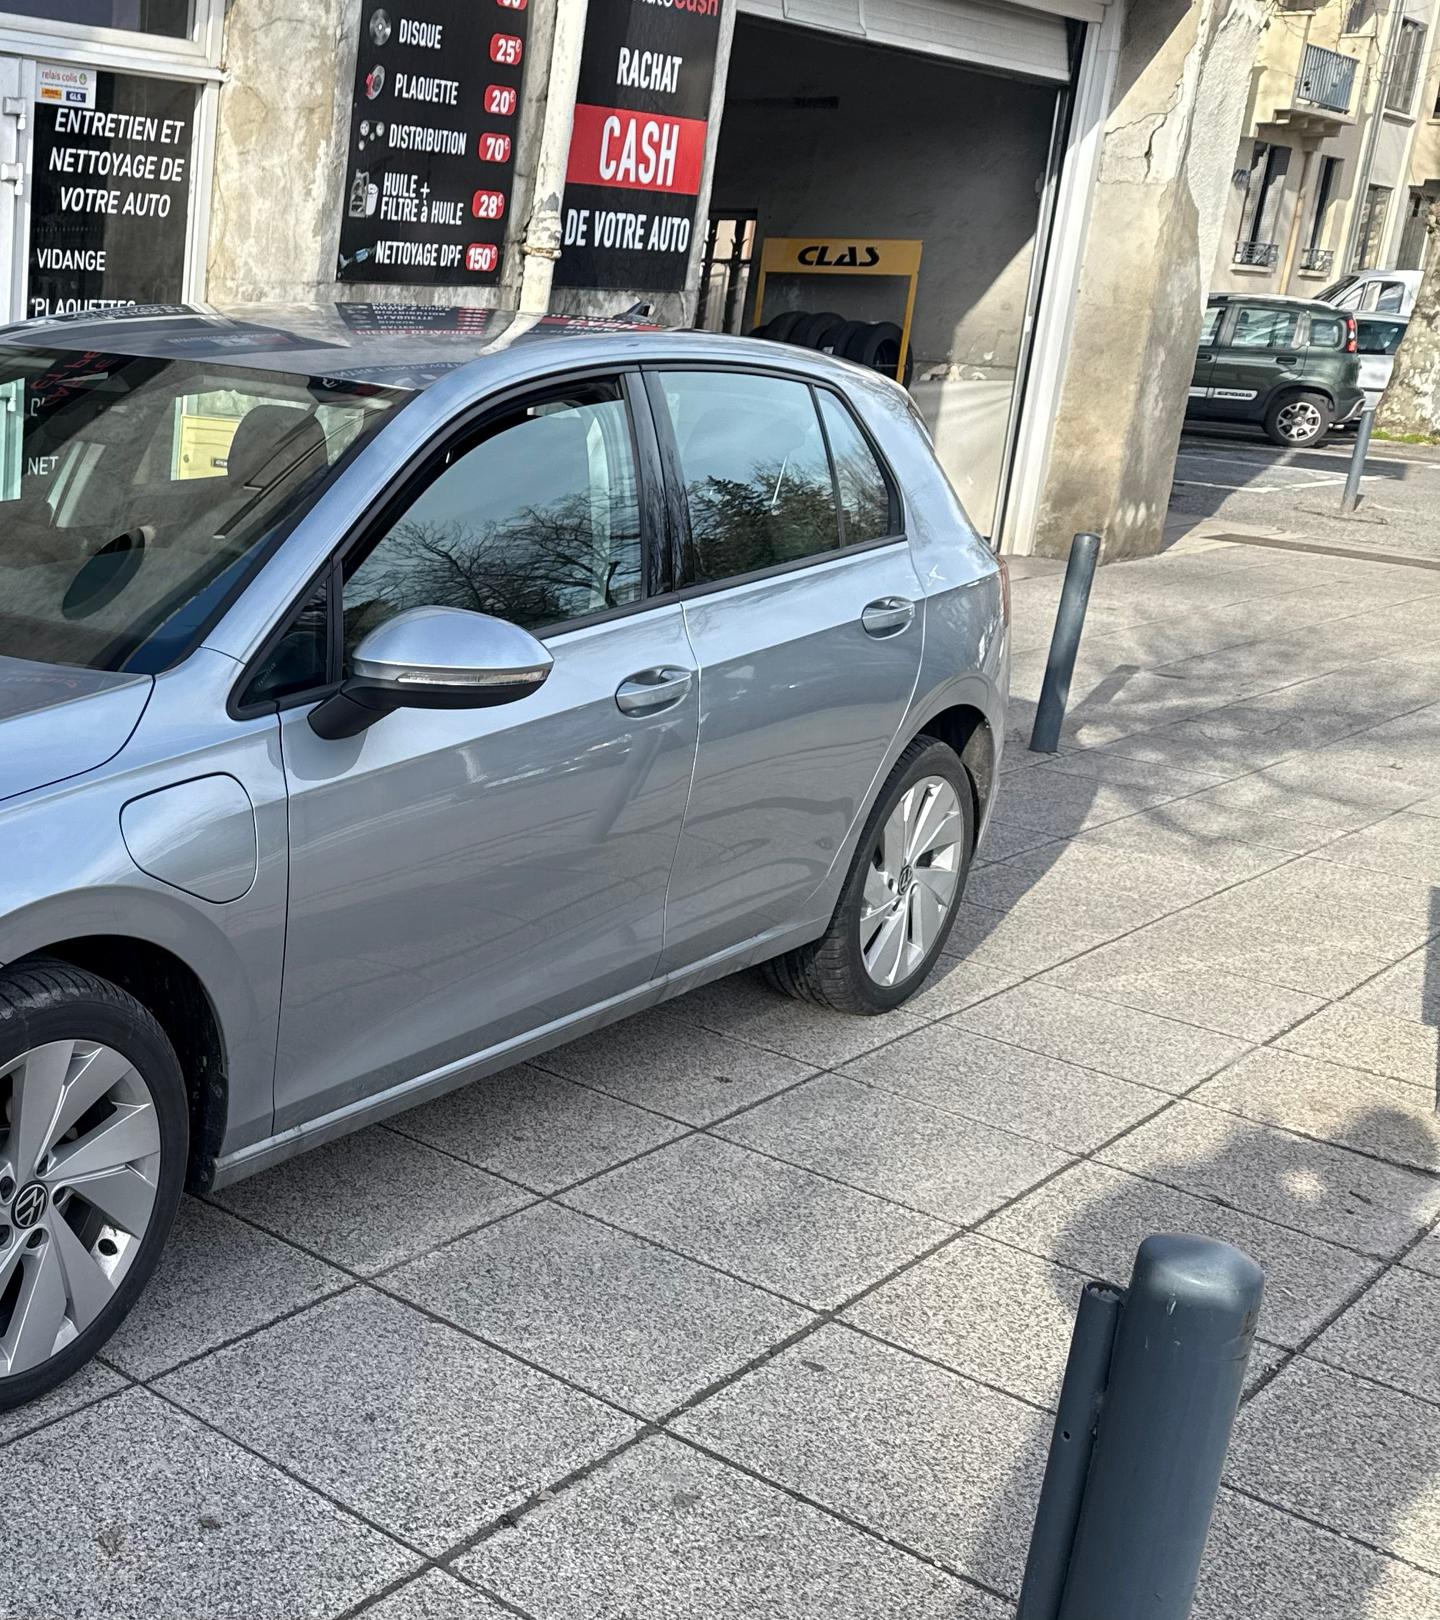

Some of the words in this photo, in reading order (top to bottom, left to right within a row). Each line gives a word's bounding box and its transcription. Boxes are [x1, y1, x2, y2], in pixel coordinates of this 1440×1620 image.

[398, 19, 443, 50] DISQUE
[616, 46, 683, 94] RACHAT
[394, 73, 460, 106] PLAQUETTE
[54, 107, 158, 142] ENTRETIEN
[160, 119, 185, 145] ET
[388, 123, 467, 156] DISTRIBUTION
[48, 146, 158, 180] NETTOYAGE
[159, 157, 185, 182] DE
[599, 115, 680, 187] CASH
[382, 172, 419, 198] HUILE
[60, 186, 121, 215] VOTRE
[122, 192, 172, 218] AUTO
[380, 196, 418, 222] FILTRE
[430, 201, 464, 225] HUILE
[564, 208, 590, 247] DE
[594, 209, 647, 250] VOTRE
[647, 215, 691, 253] AUTO
[36, 247, 107, 272] VIDANGE
[374, 240, 439, 267] NETTOYAGE
[439, 244, 463, 268] DPF
[796, 245, 880, 267] CLAS
